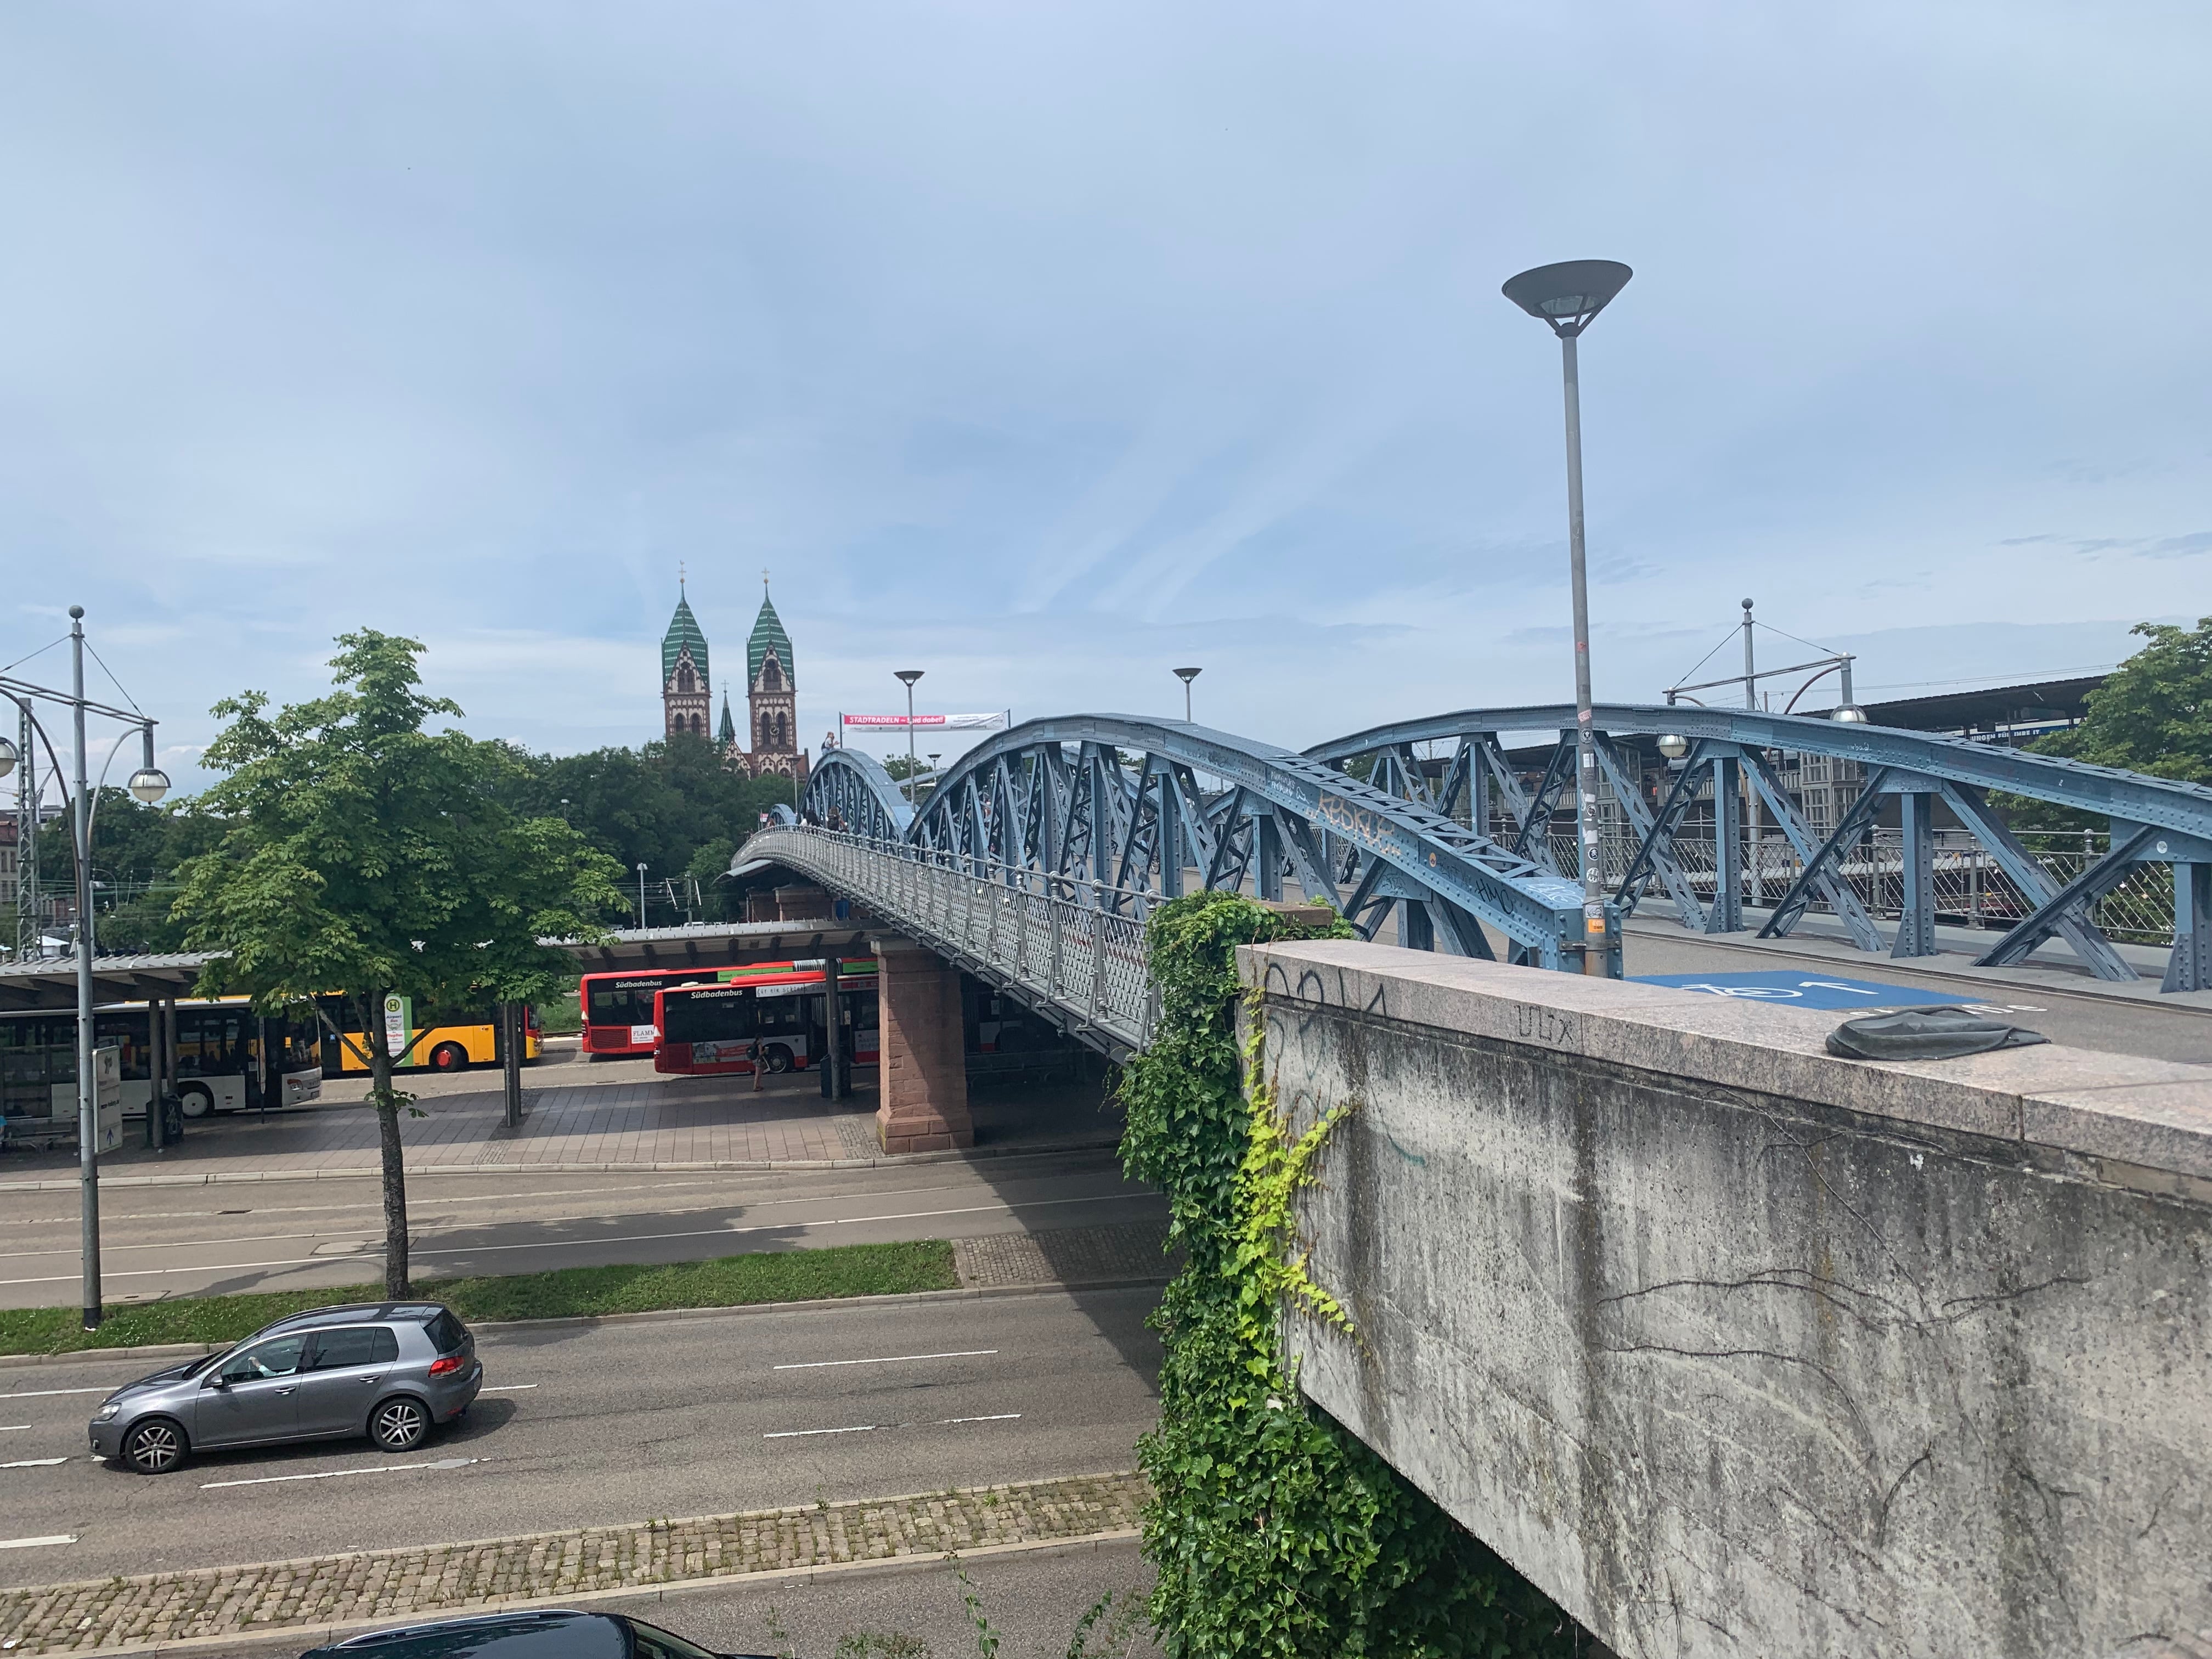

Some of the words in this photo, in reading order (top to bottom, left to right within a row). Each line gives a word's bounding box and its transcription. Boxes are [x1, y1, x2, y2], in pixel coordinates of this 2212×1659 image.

[1970, 733, 1996, 741] UNGEN
[615, 980, 662, 989] Südbadenbus
[690, 990, 743, 999] Südbadenbus
[390, 1002, 397, 1010] H
